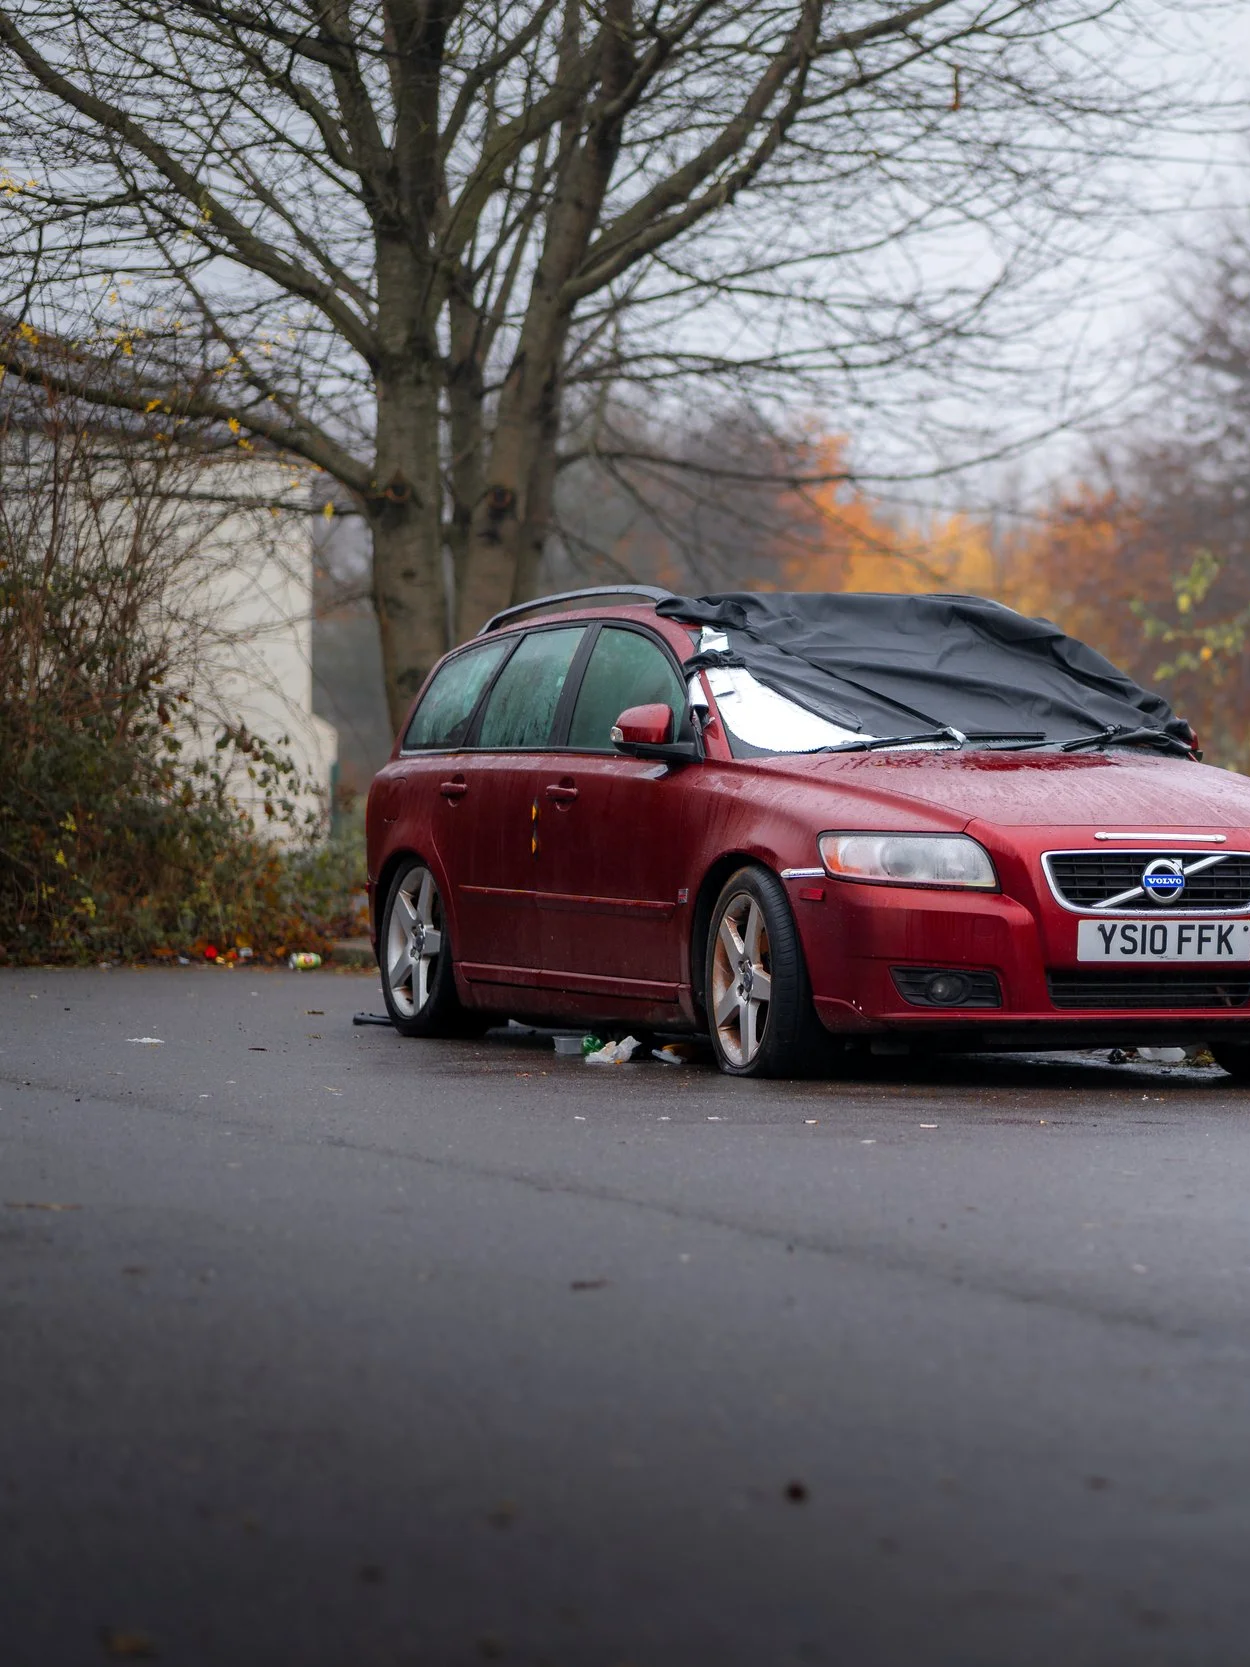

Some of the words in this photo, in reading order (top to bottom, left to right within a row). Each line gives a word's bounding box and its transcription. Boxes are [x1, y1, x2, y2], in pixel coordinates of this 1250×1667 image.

[1147, 877, 1182, 885] VOLVO
[1100, 924, 1168, 955] YS10
[1177, 924, 1235, 955] FFK
